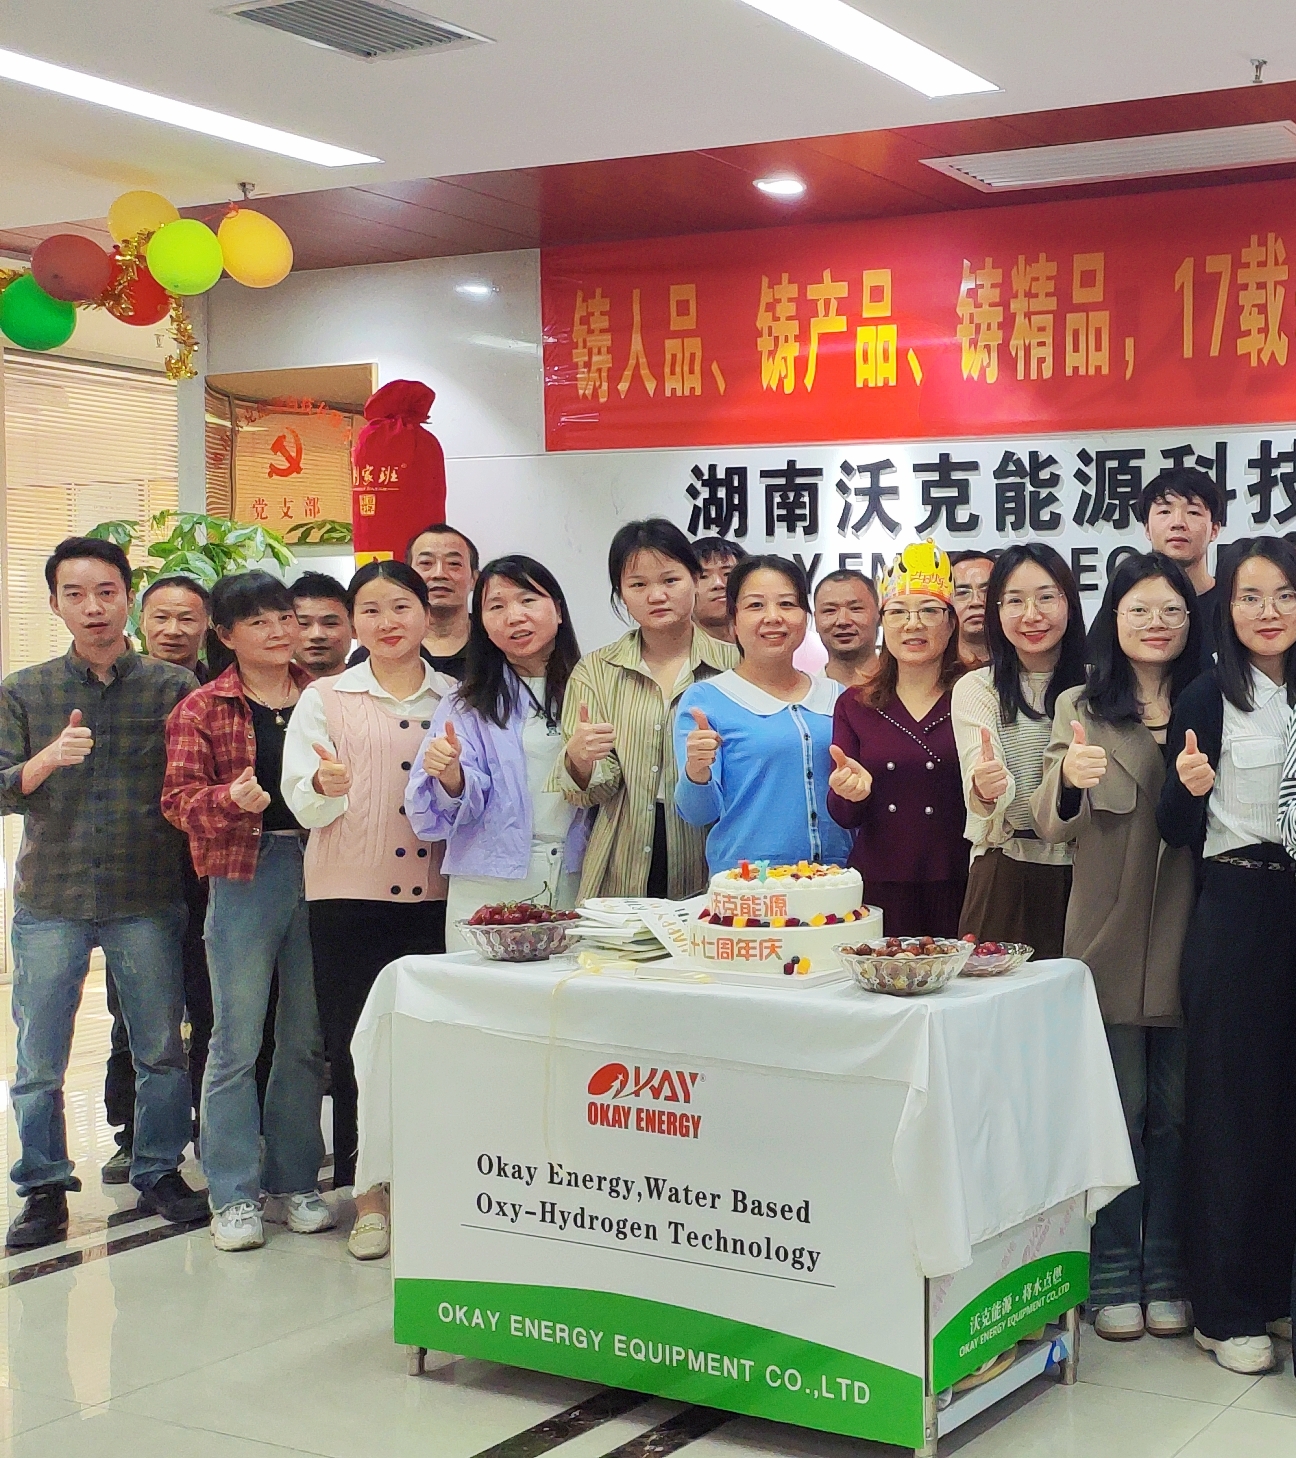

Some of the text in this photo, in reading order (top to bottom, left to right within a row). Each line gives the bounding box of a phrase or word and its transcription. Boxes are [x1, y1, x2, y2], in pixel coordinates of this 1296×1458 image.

[253, 497, 320, 520] 党支部
[690, 932, 783, 962] 十七周年庆
[588, 1102, 702, 1139] OKAY ENERGY
[477, 1153, 538, 1186] Okay
[731, 1189, 811, 1224] Based
[476, 1192, 821, 1272] Oxy-Hydrogen Technology
[438, 1302, 870, 1405] OKAY ENERGY EQUIPMENT CO.,LTD
[959, 1340, 979, 1358] OKAY
[979, 1319, 1006, 1346] ENERGY
[1007, 1297, 1045, 1329] EQUIPMENT
